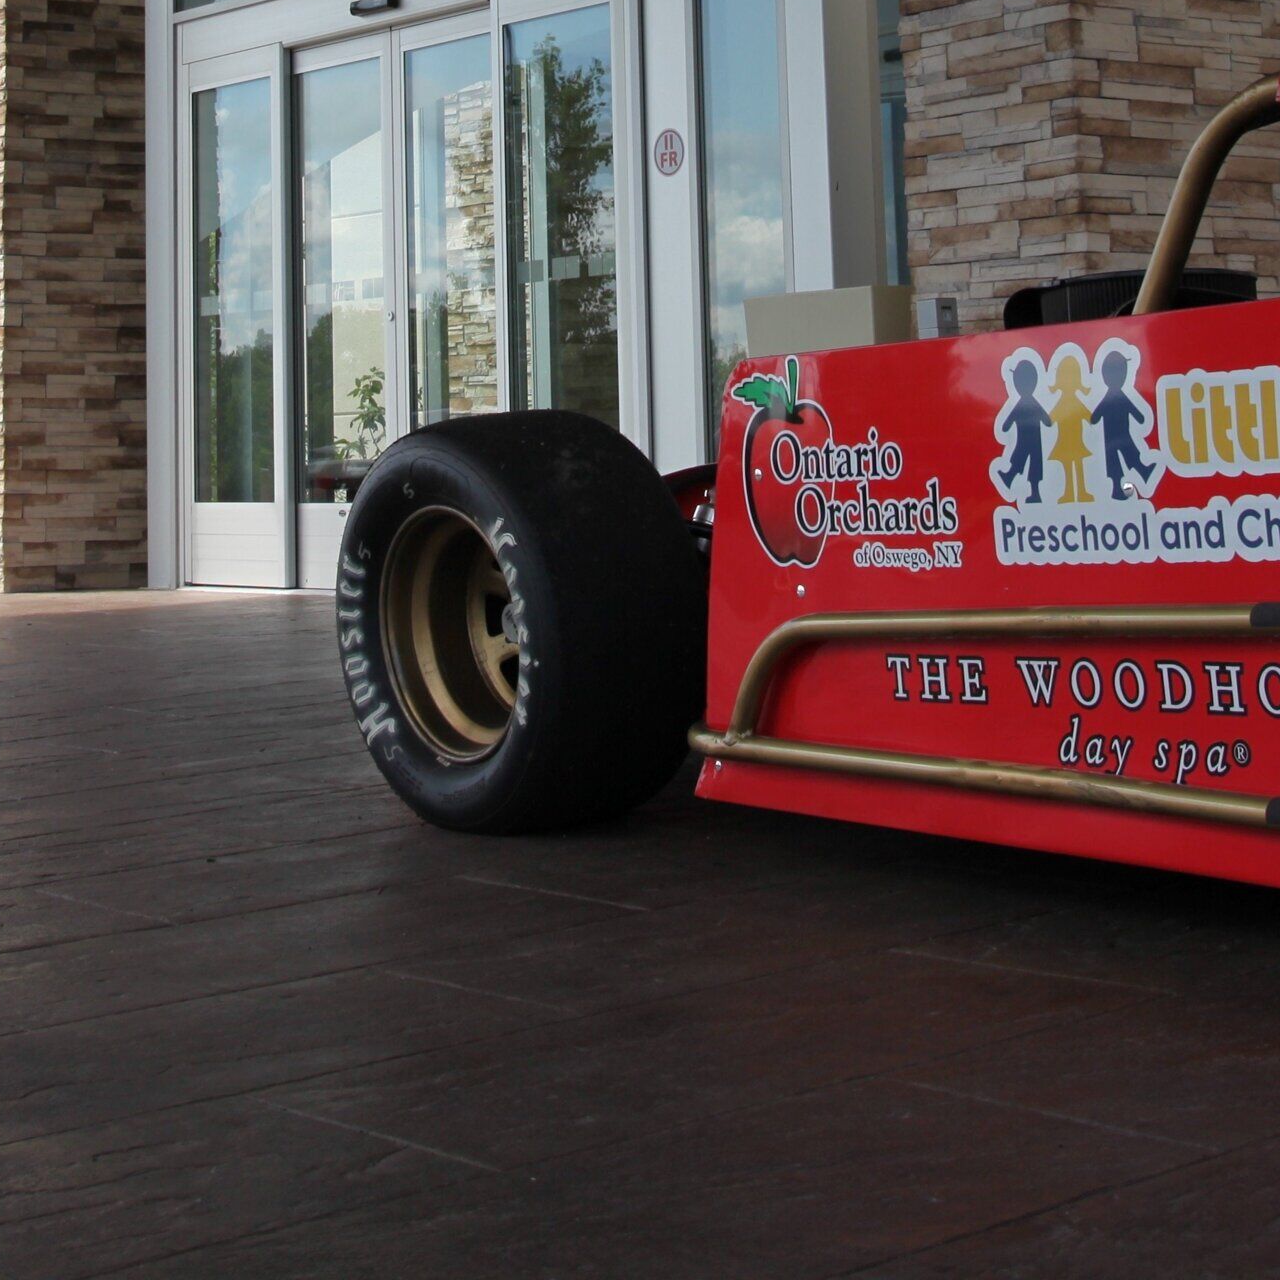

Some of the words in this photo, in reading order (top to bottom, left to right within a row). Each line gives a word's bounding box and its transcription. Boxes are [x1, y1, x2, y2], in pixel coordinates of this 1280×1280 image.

[660, 151, 678, 169] FR
[772, 428, 902, 482] Ontario
[796, 481, 958, 535] Orchards
[1001, 516, 1150, 554] Preschool
[1159, 510, 1223, 549] and
[855, 544, 870, 565] of
[872, 545, 932, 570] Oswego,
[935, 545, 962, 565] NY
[887, 656, 987, 702] THE
[1059, 716, 1133, 777] day
